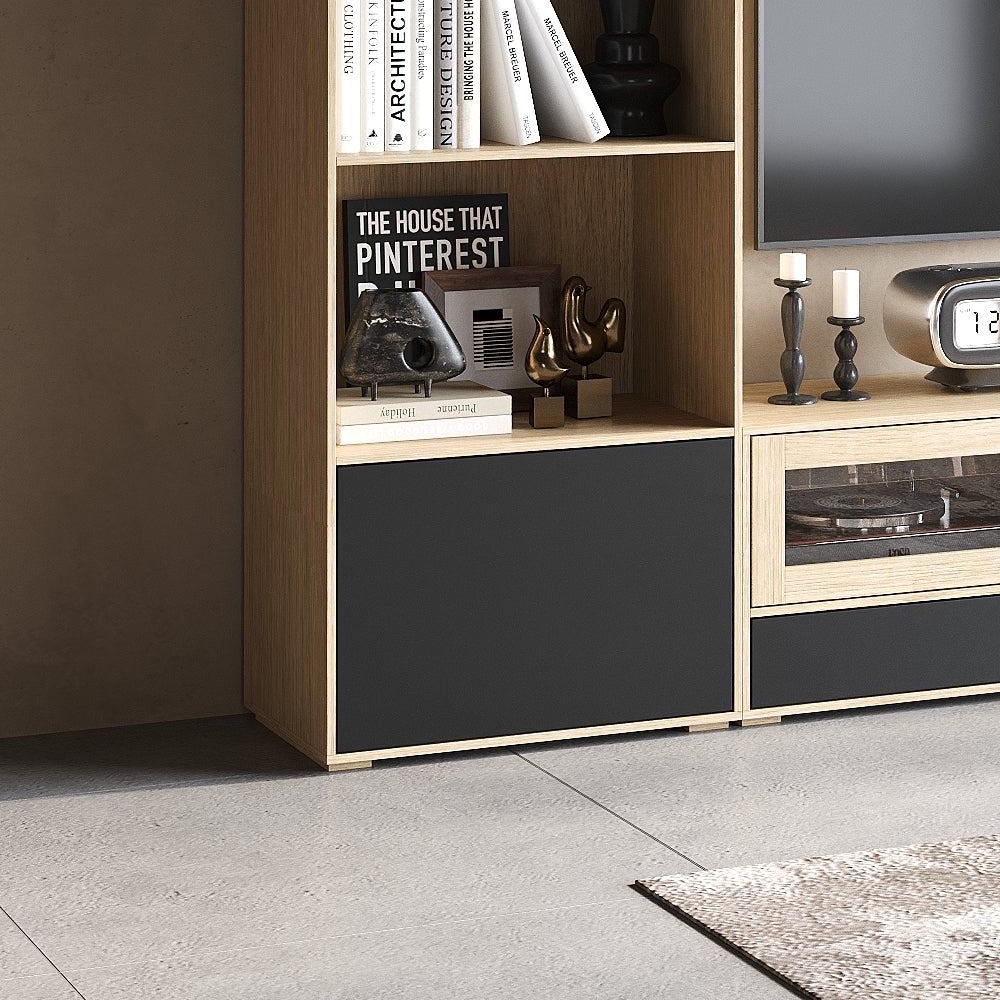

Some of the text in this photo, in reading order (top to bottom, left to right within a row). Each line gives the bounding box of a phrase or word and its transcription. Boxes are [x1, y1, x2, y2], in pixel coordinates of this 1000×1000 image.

[343, 4, 354, 74] CLOTHING
[368, 2, 379, 65] KINFOLK
[463, 10, 474, 38] HOUSE
[463, 41, 474, 57] THE
[501, 10, 522, 82] MARCEL BREUER
[543, 17, 579, 83] MARCEL BREUER
[463, 60, 474, 100] BRINGING
[440, 68, 453, 147] DESIGN
[356, 206, 503, 235] THE HOUSE THAT
[356, 236, 504, 276] PINTEREST
[973, 310, 999, 334] 12
[380, 406, 416, 419] Holiday
